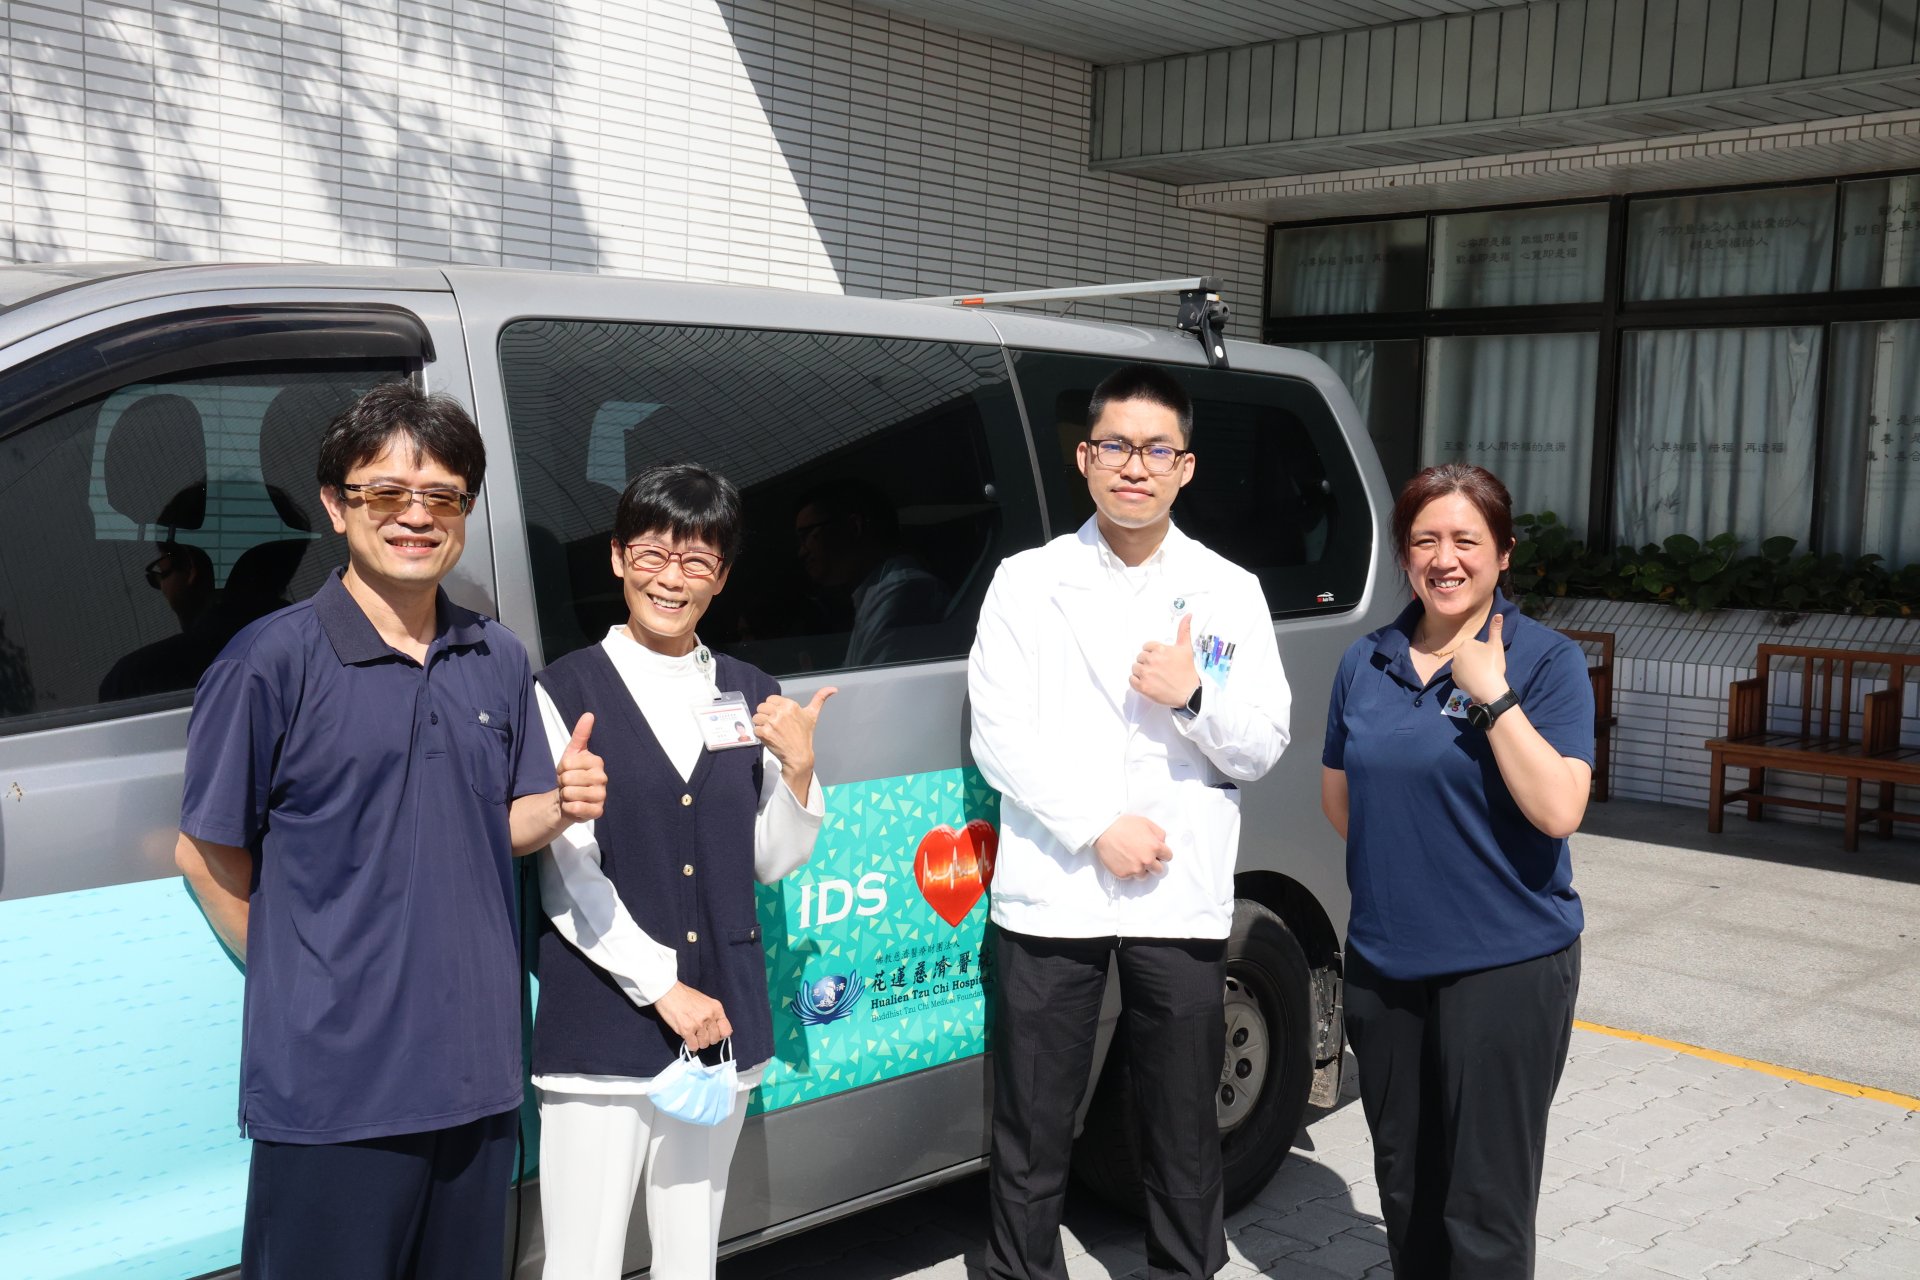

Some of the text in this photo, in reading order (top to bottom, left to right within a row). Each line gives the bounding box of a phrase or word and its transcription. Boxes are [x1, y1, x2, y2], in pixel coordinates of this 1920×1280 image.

[799, 871, 888, 929] IDS
[872, 947, 993, 993] 花蓮慈濟醫院
[871, 992, 909, 1010] Hualien
[912, 989, 930, 1000] Tzu
[933, 983, 949, 994] Chi
[871, 988, 992, 1023] Buddhist Tzu Chi Medical Foundat
